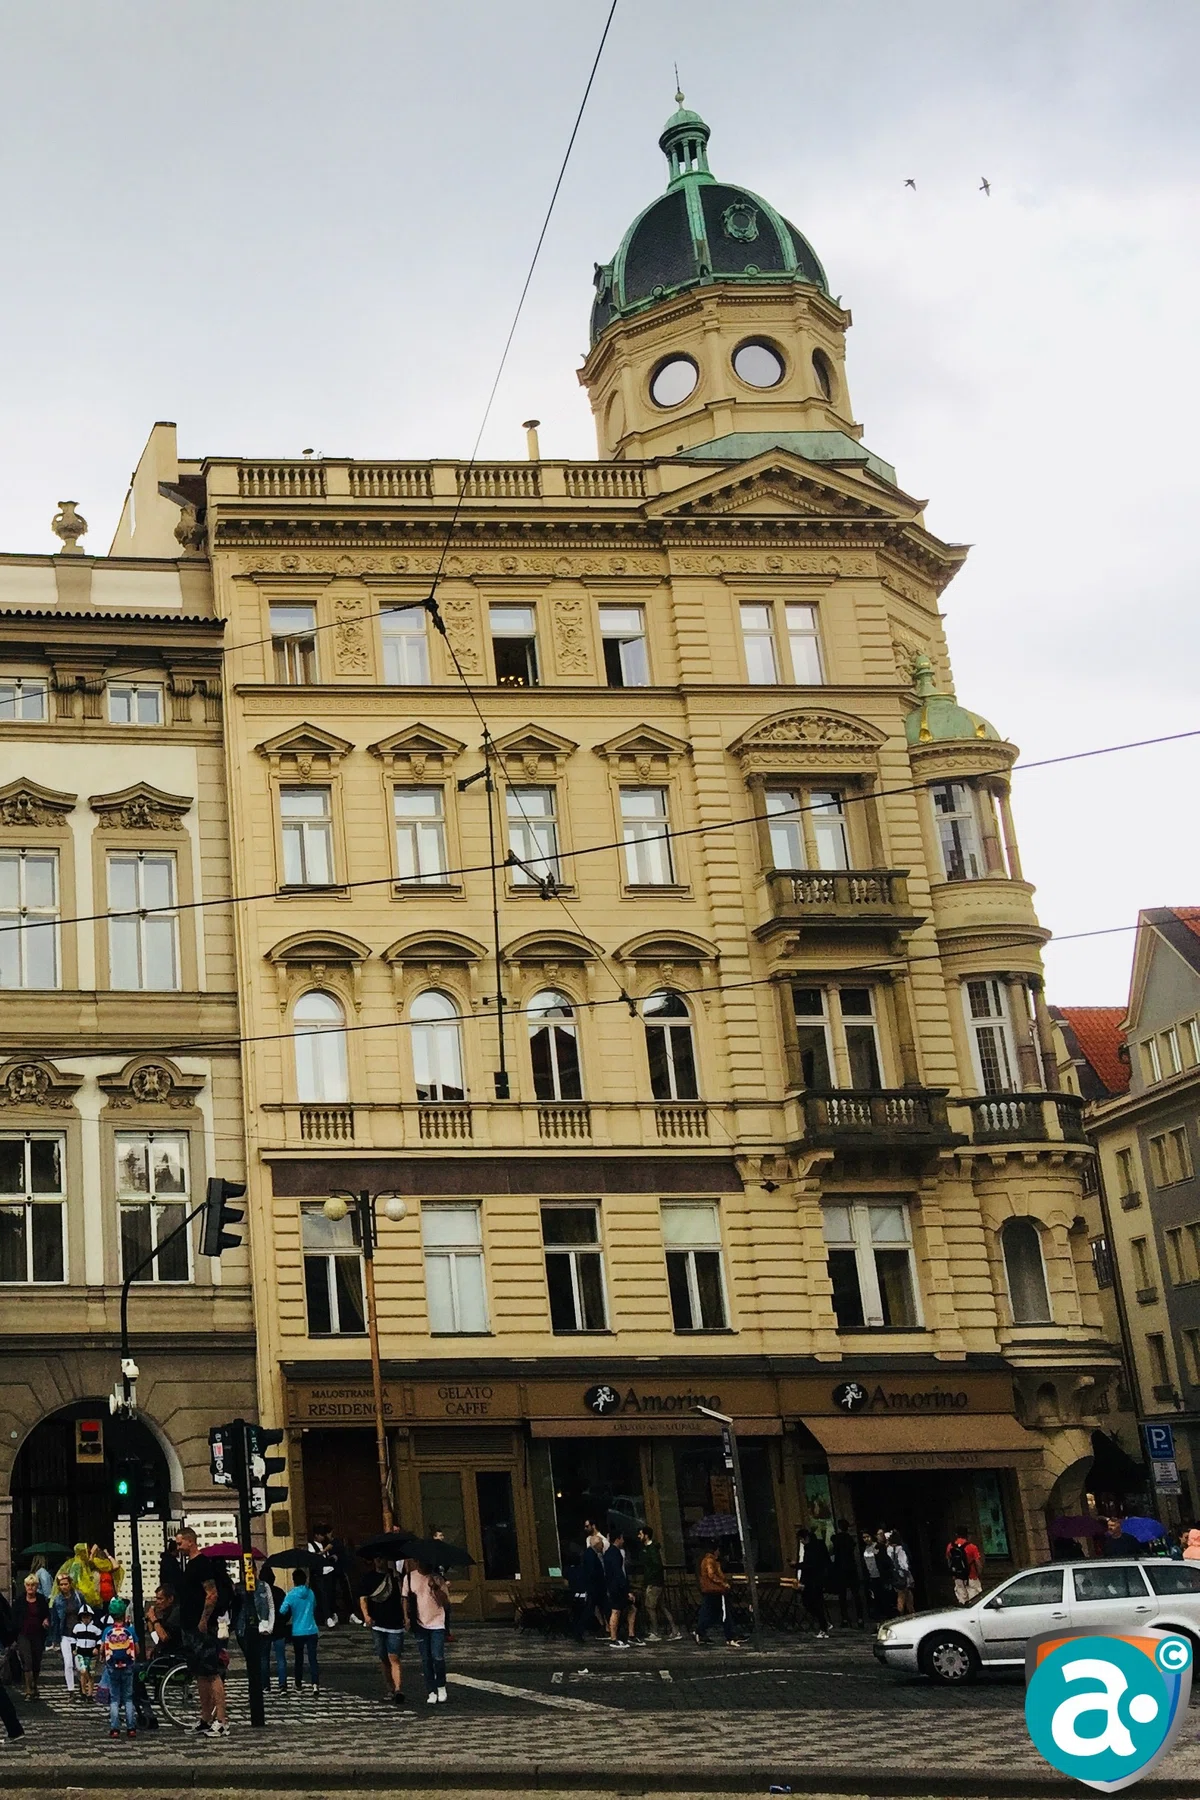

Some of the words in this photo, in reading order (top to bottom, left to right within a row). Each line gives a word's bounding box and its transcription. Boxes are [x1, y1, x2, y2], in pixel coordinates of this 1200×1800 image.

[311, 1387, 389, 1399] MALOSTRANSÁ
[437, 1386, 493, 1400] GELATO
[620, 1387, 722, 1413] Amorino
[868, 1384, 969, 1410] Amorino
[1150, 1428, 1166, 1449] P
